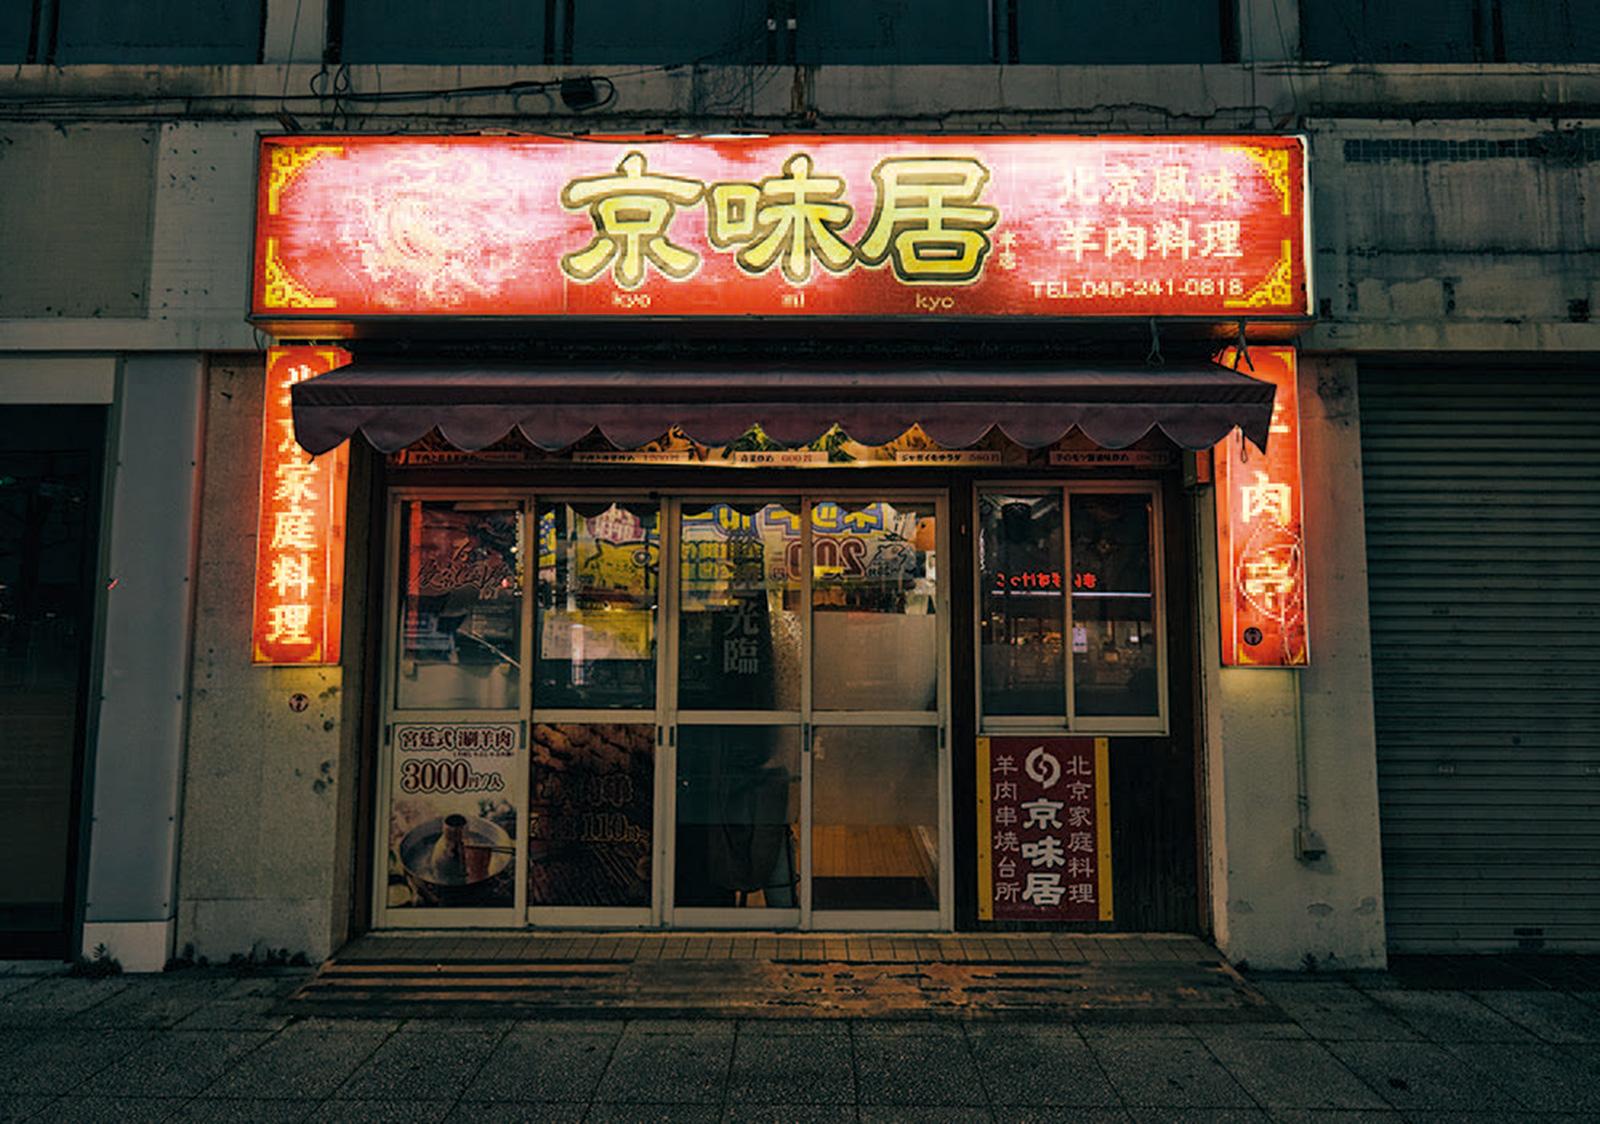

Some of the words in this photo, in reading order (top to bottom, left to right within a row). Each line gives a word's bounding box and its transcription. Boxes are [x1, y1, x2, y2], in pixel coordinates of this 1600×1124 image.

[561, 150, 999, 288] 京味居
[1057, 163, 1240, 206] 北京風味
[1056, 216, 1243, 261] 羊肉料理
[915, 292, 954, 310] kyo
[1020, 798, 1066, 907] 京味居
[1066, 755, 1096, 904] 北京家庭料理
